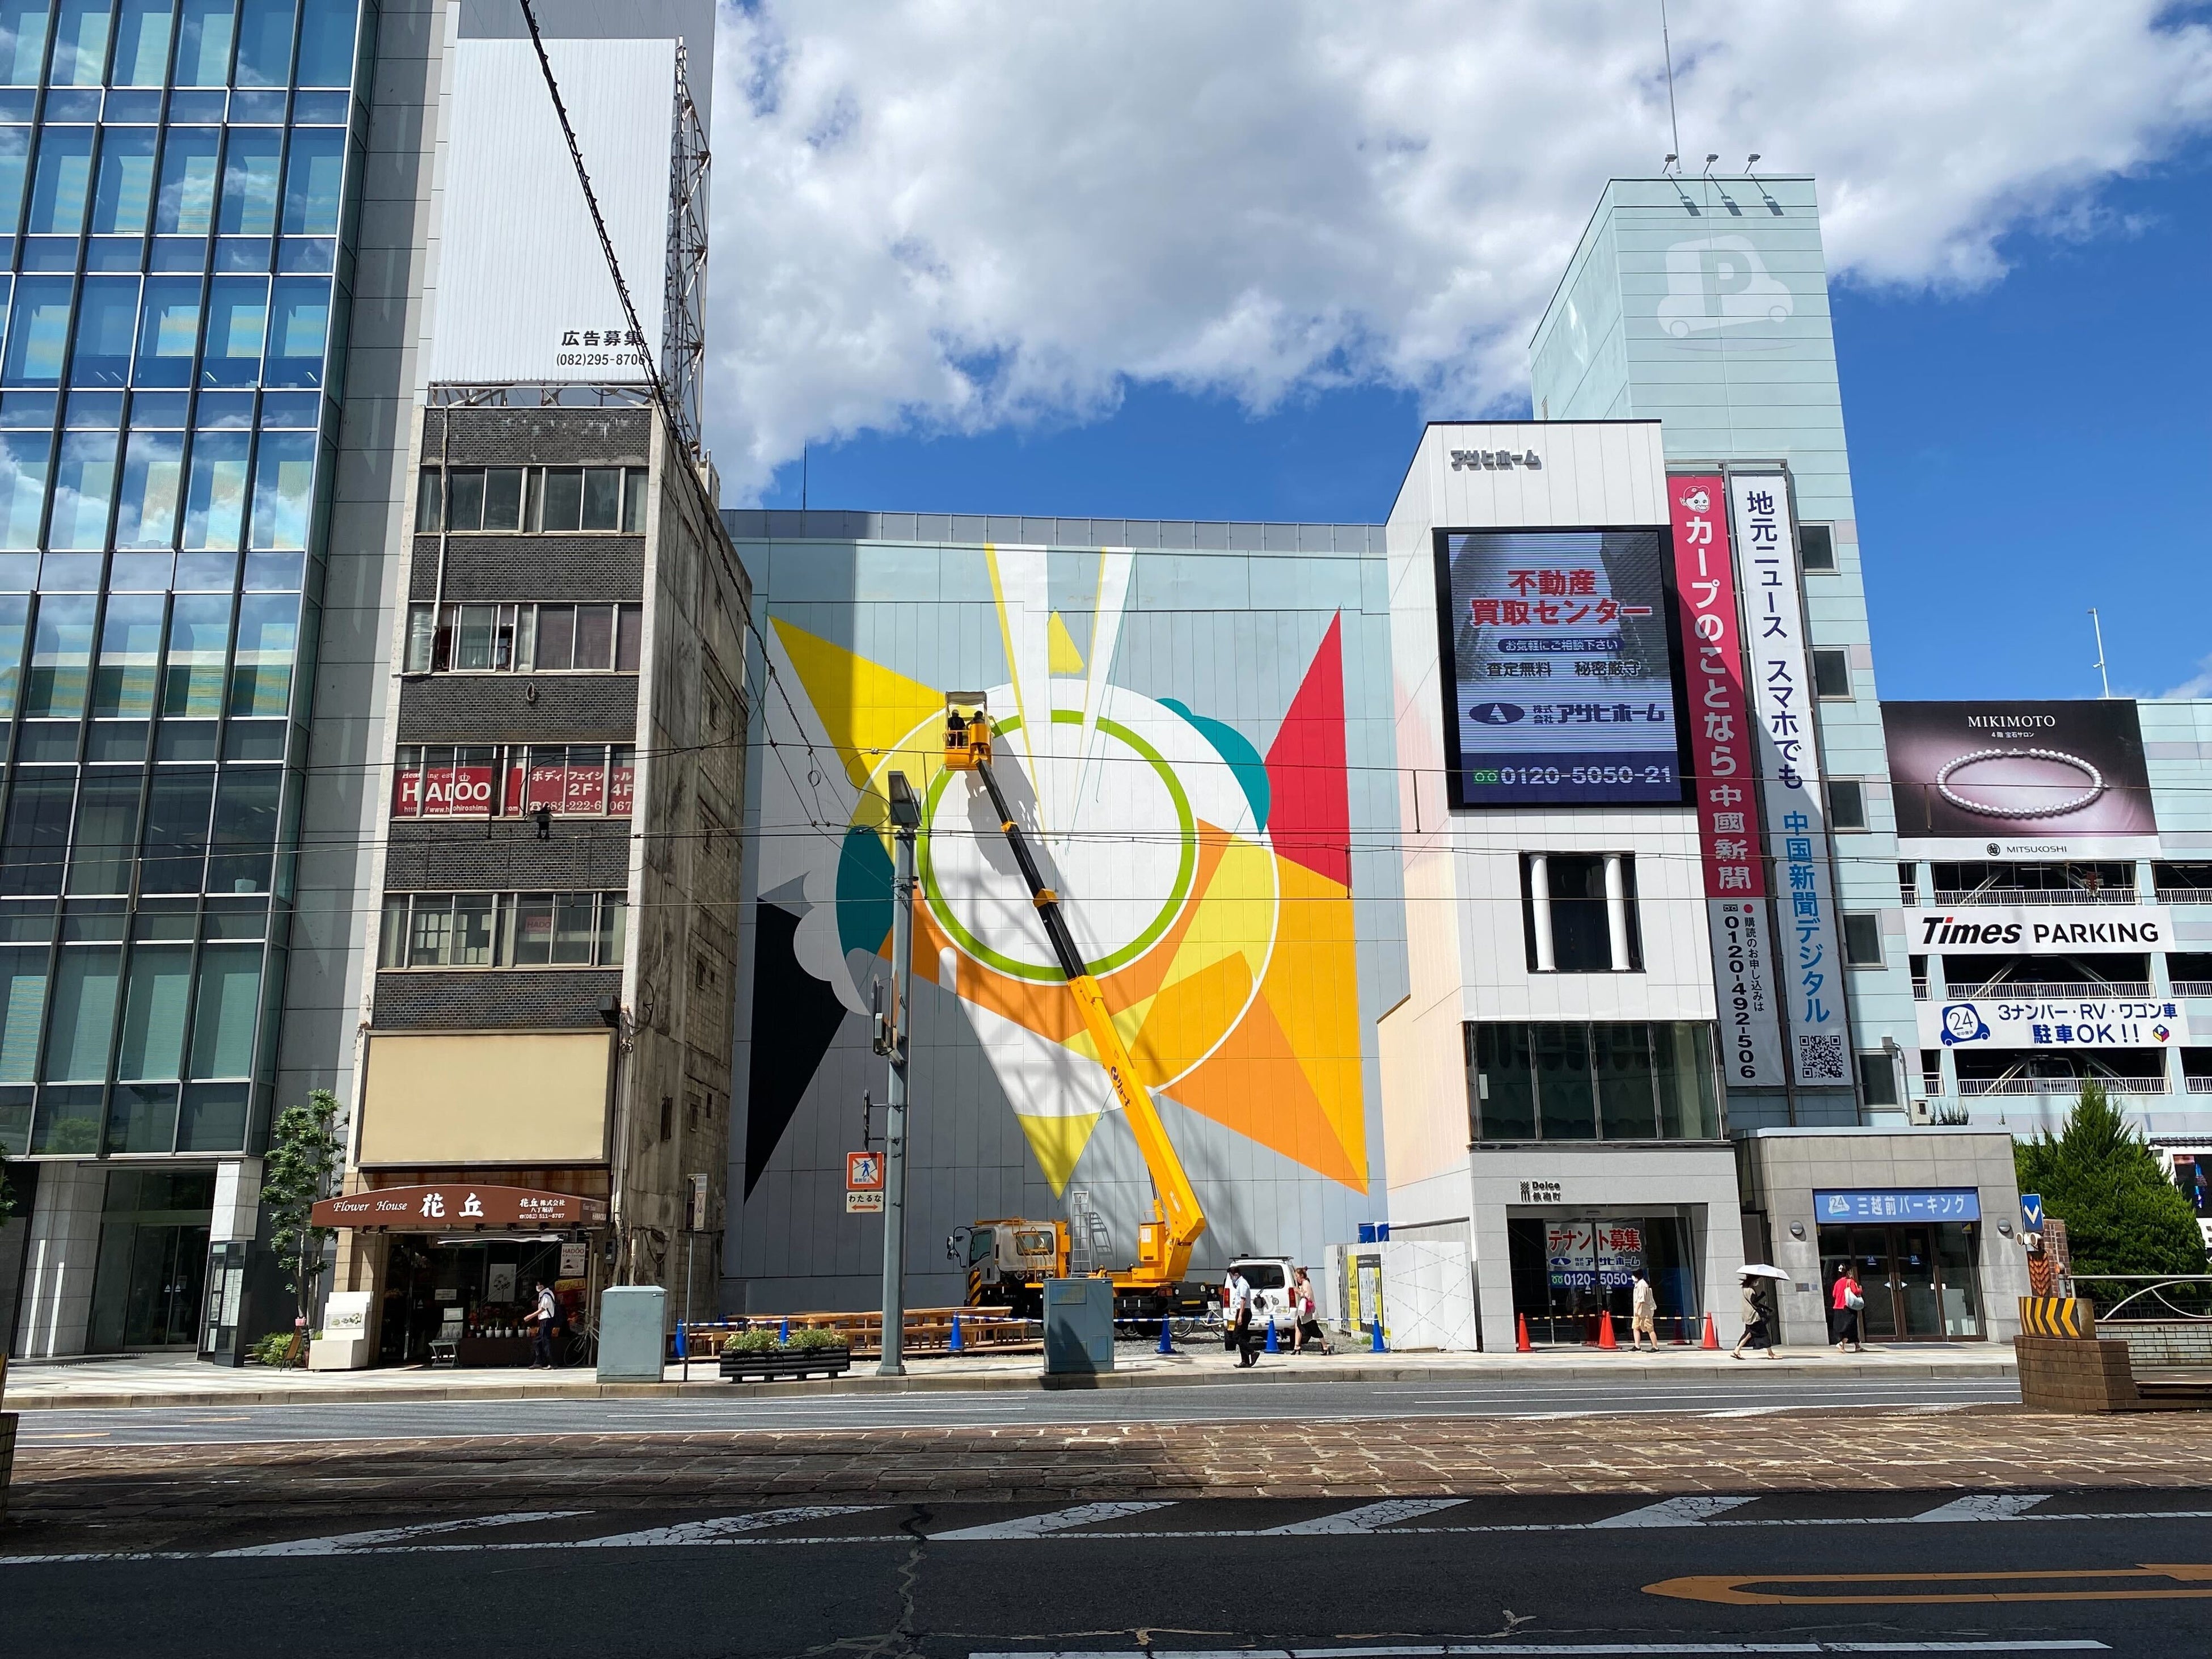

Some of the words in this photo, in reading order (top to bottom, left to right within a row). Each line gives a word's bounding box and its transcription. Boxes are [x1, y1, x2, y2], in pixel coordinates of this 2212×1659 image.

[561, 330, 642, 346] 広告募集
[1450, 450, 1540, 467] アサヒホーム
[1747, 491, 1788, 638] 地元ニュース
[1508, 569, 1597, 596] 不動産
[1471, 598, 1652, 626] 買取センター
[1505, 639, 1618, 651] お気軽にご相談下さい
[1486, 661, 1552, 677] 査定無料
[1574, 660, 1641, 676] 秘密厳守
[1533, 705, 1553, 714] 株式
[1556, 703, 1665, 724] アサヒホーム
[1533, 715, 1554, 724] 会社
[1768, 660, 1803, 790] スマホでも
[1968, 715, 2055, 727] MIKIMOTO
[1501, 766, 1671, 784] 0120-5050-21
[1783, 810, 1830, 1023] 中国新聞デジタル
[1922, 917, 2023, 944] Times
[2033, 923, 2159, 943] PARKING
[1744, 917, 1764, 1012] 購読のお申し込みは
[1724, 916, 1756, 1079] 0120-492-506
[1949, 1010, 1973, 1030] 24
[1532, 1181, 1561, 1191] Dolce
[333, 1200, 370, 1212] Flower
[375, 1200, 408, 1211] House
[1857, 1195, 1965, 1215] 三越前パーキング
[1548, 1228, 1641, 1252] テナント募集
[1585, 1256, 1640, 1266] アサヒホーム
[1564, 1273, 1635, 1286] 0120-5050-
